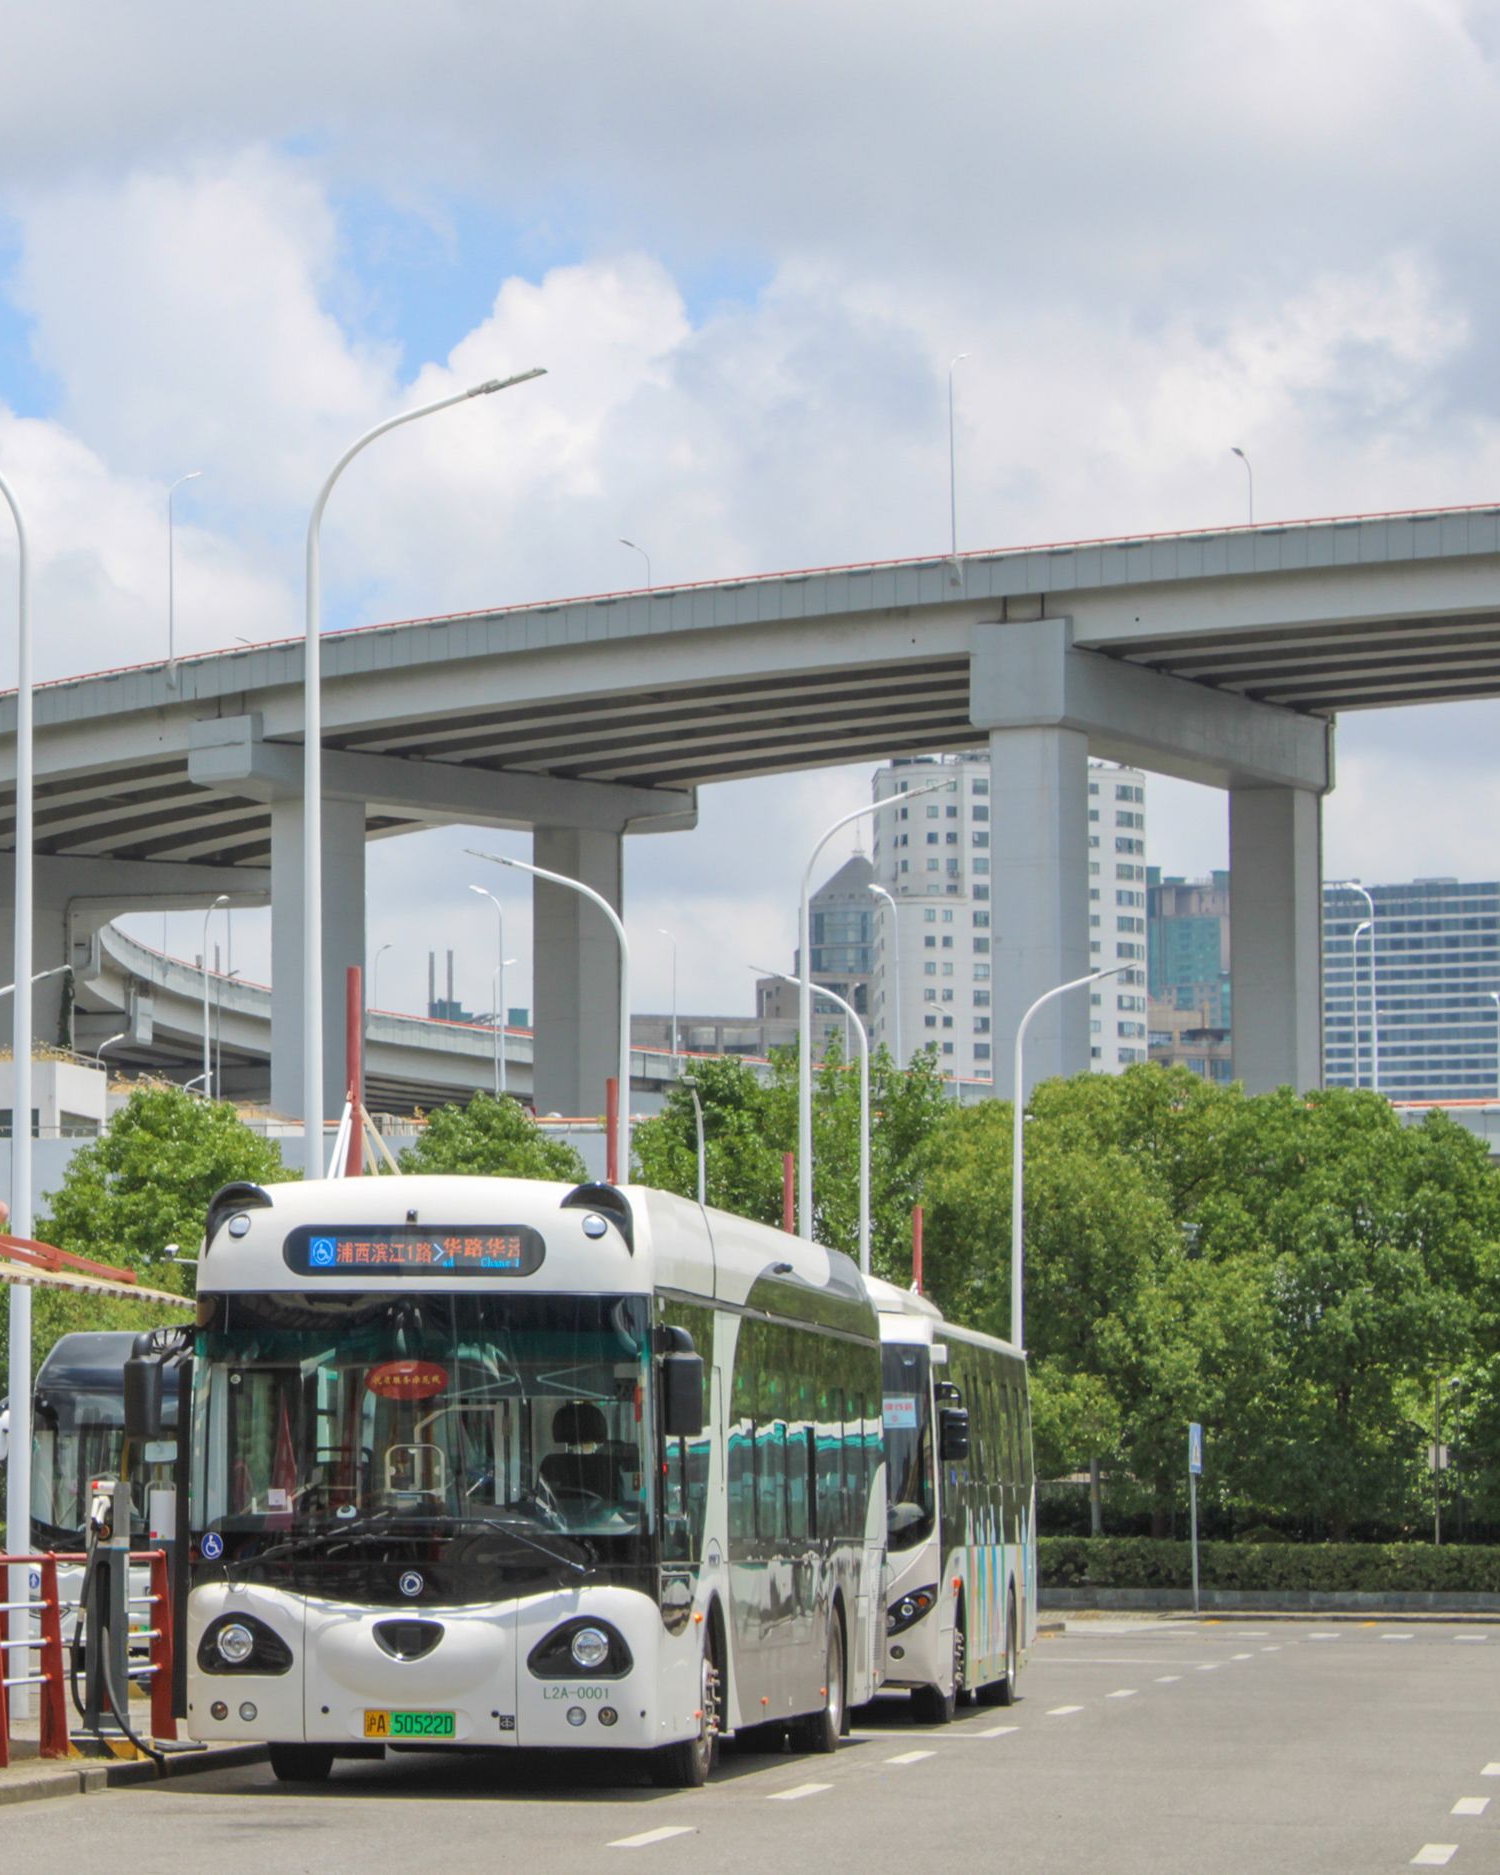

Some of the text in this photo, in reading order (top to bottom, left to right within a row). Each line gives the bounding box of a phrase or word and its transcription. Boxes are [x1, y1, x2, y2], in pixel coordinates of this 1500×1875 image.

[336, 1242, 433, 1264] 浦西滨江1路
[543, 1687, 610, 1700] L2A-0001
[366, 1714, 454, 1735] 沪A 50522D
